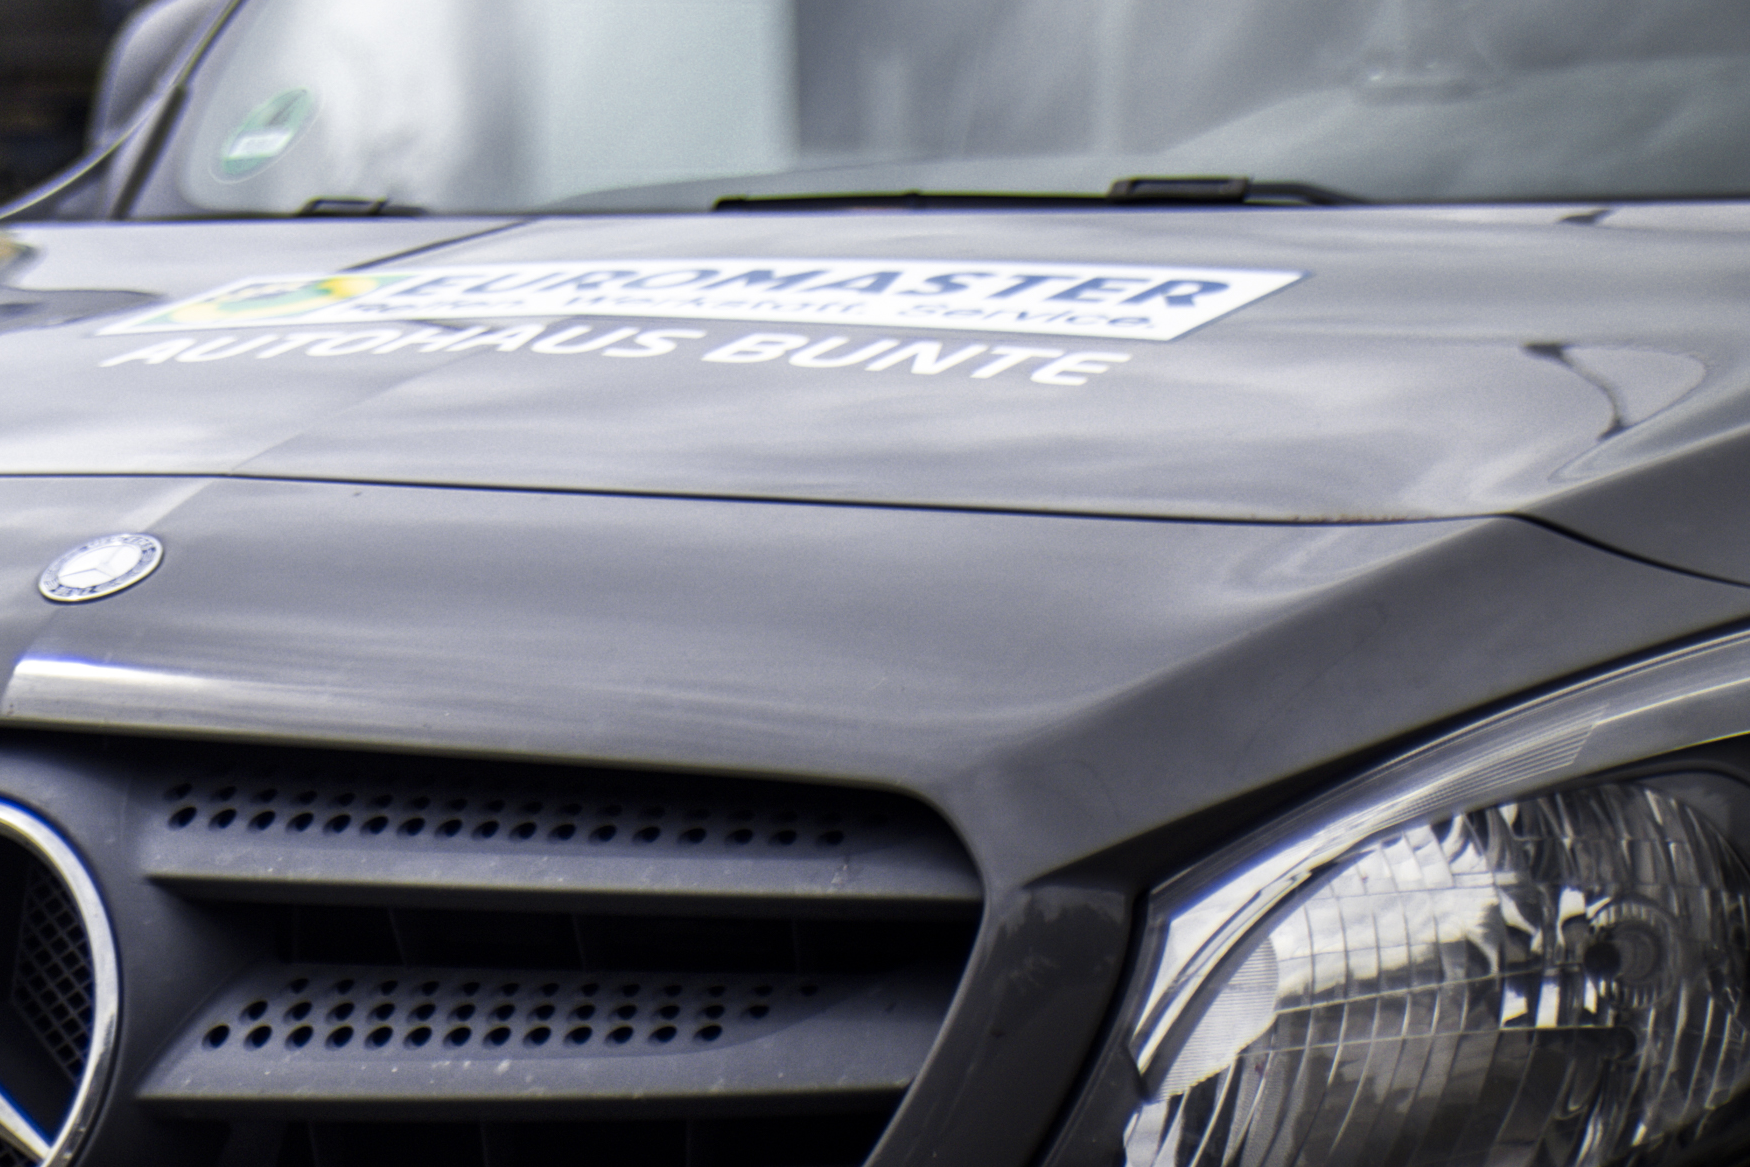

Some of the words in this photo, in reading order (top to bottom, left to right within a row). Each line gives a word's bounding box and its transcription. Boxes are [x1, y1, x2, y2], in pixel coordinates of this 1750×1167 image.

[388, 269, 1232, 309] EUROMASTER
[98, 323, 708, 368] AUTOHAUS
[700, 332, 1134, 386] BUNTE
